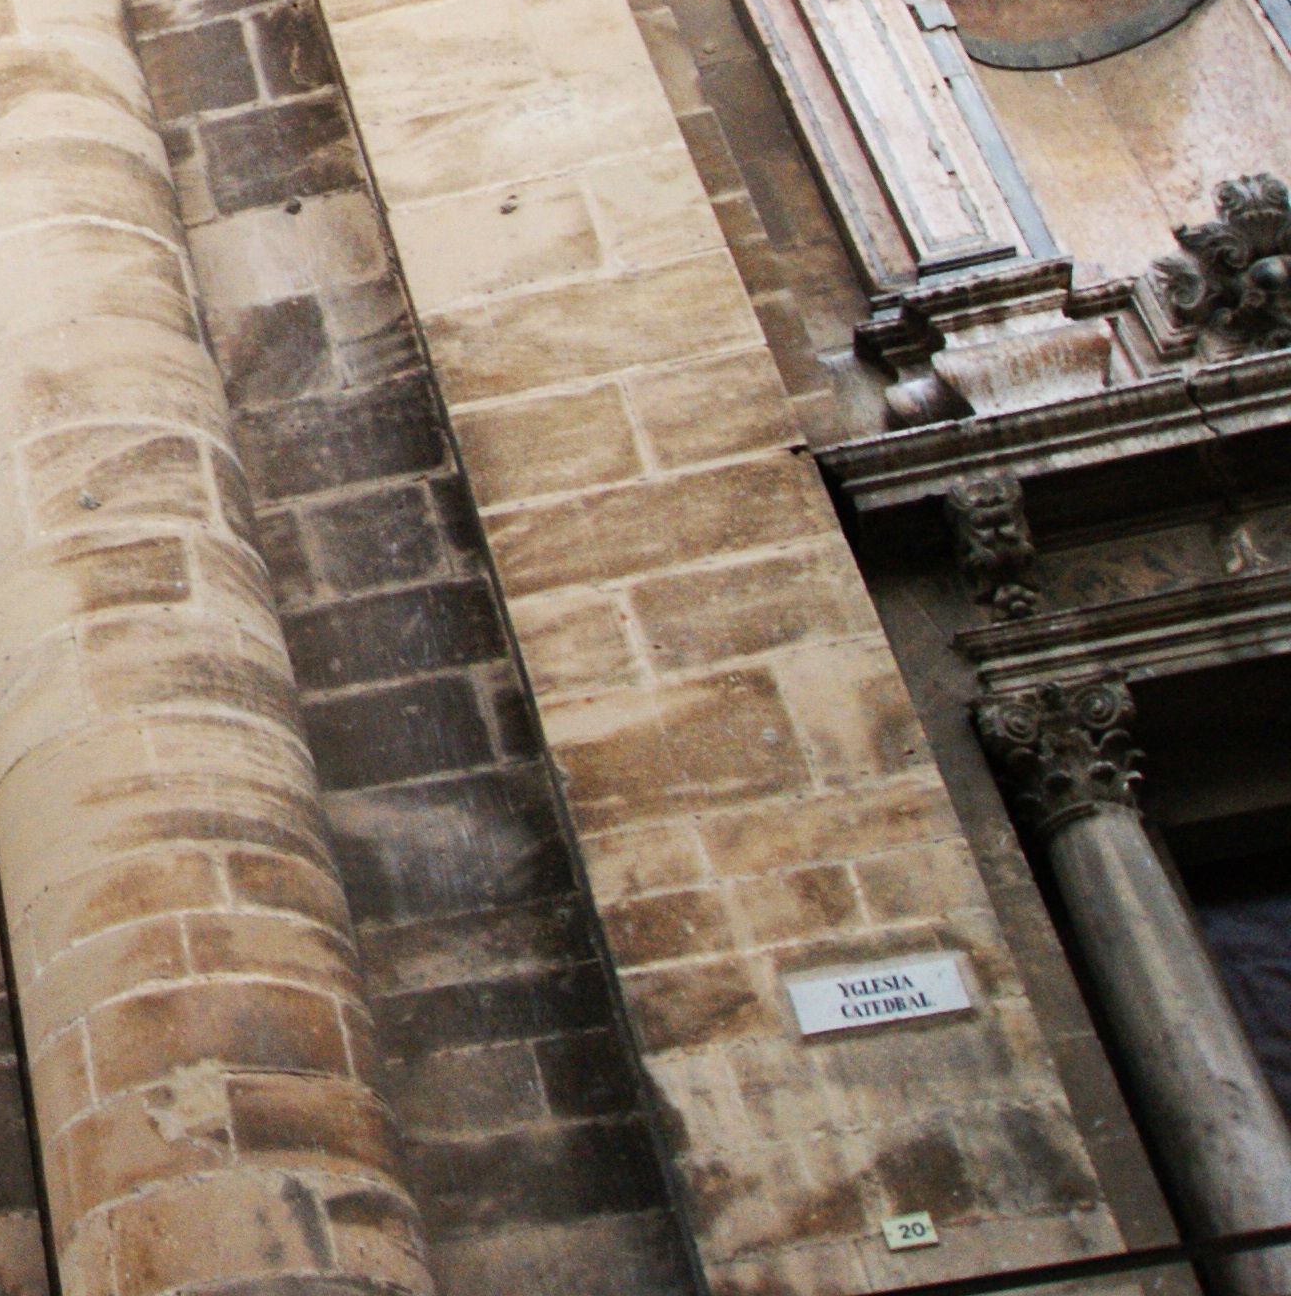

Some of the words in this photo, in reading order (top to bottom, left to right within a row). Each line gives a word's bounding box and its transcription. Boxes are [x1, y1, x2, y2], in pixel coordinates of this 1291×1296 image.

[837, 974, 914, 998] YGLESIA
[841, 991, 934, 1018] CATEDRAL
[898, 1222, 926, 1240] 20
